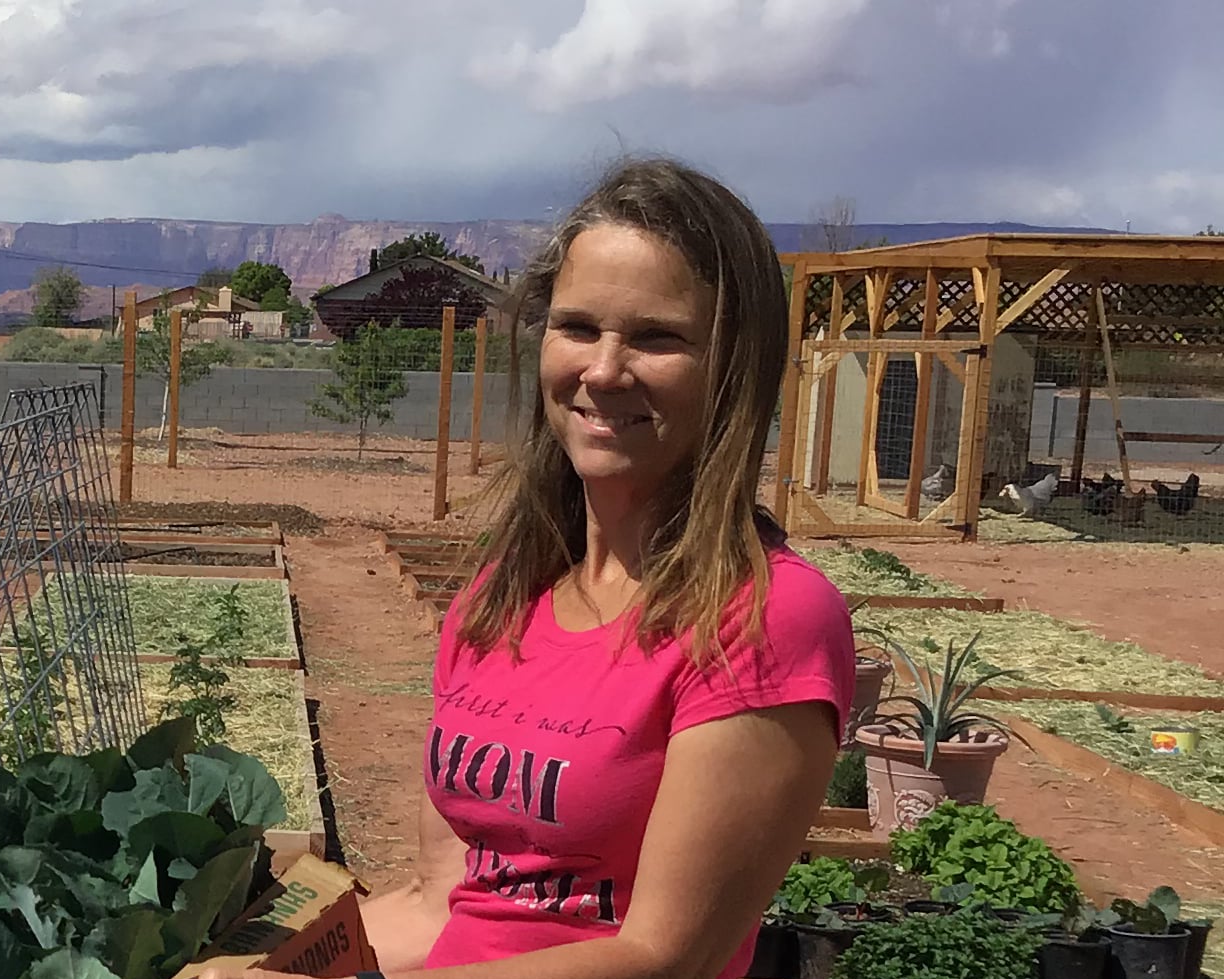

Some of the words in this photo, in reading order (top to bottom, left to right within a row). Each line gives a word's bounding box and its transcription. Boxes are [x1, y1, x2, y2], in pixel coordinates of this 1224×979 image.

[438, 683, 509, 717] first
[537, 718, 627, 738] was
[425, 724, 571, 827] MOM
